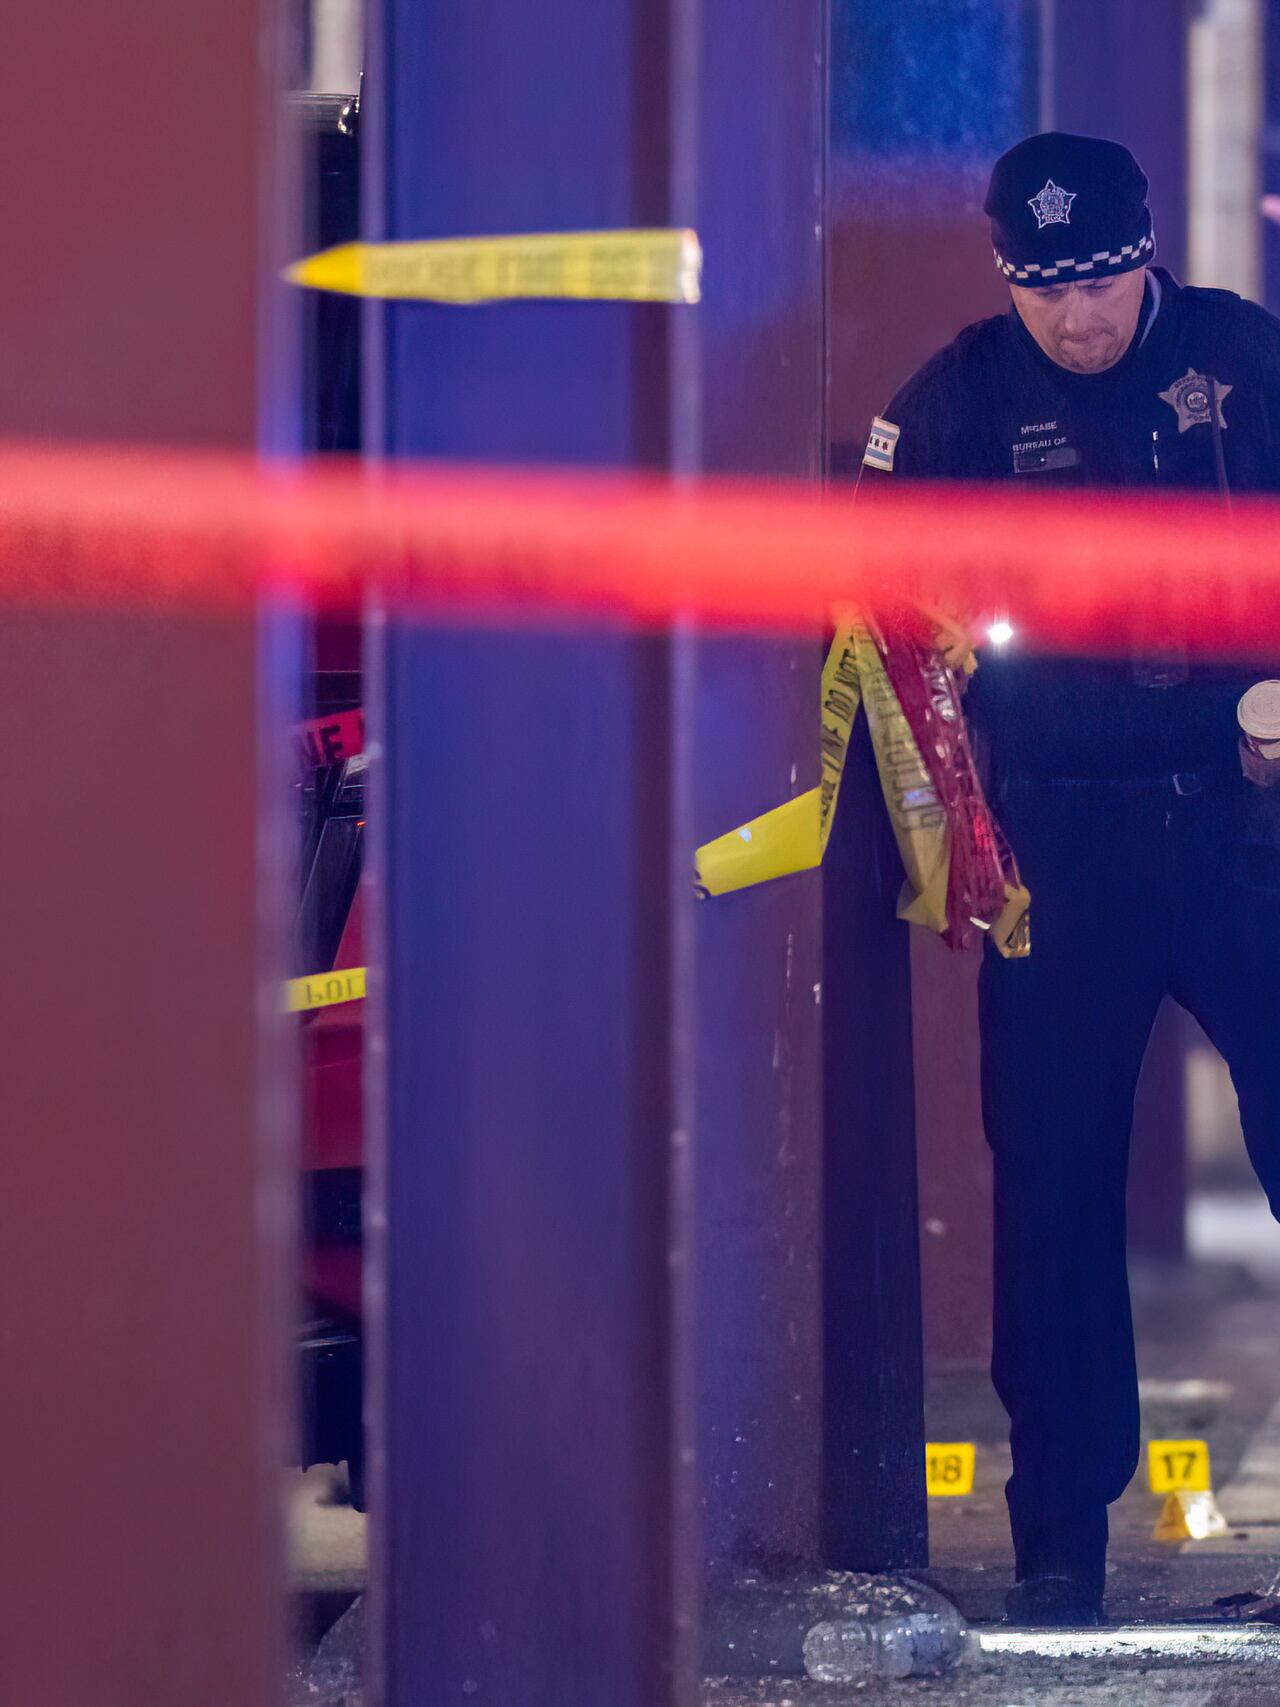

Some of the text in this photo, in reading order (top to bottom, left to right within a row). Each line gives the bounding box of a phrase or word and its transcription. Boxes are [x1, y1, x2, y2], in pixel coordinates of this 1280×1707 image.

[1012, 436, 1067, 452] BUREAU OF
[824, 689, 854, 723] DO
[928, 1456, 963, 1484] 18
[1161, 1452, 1198, 1480] 17
